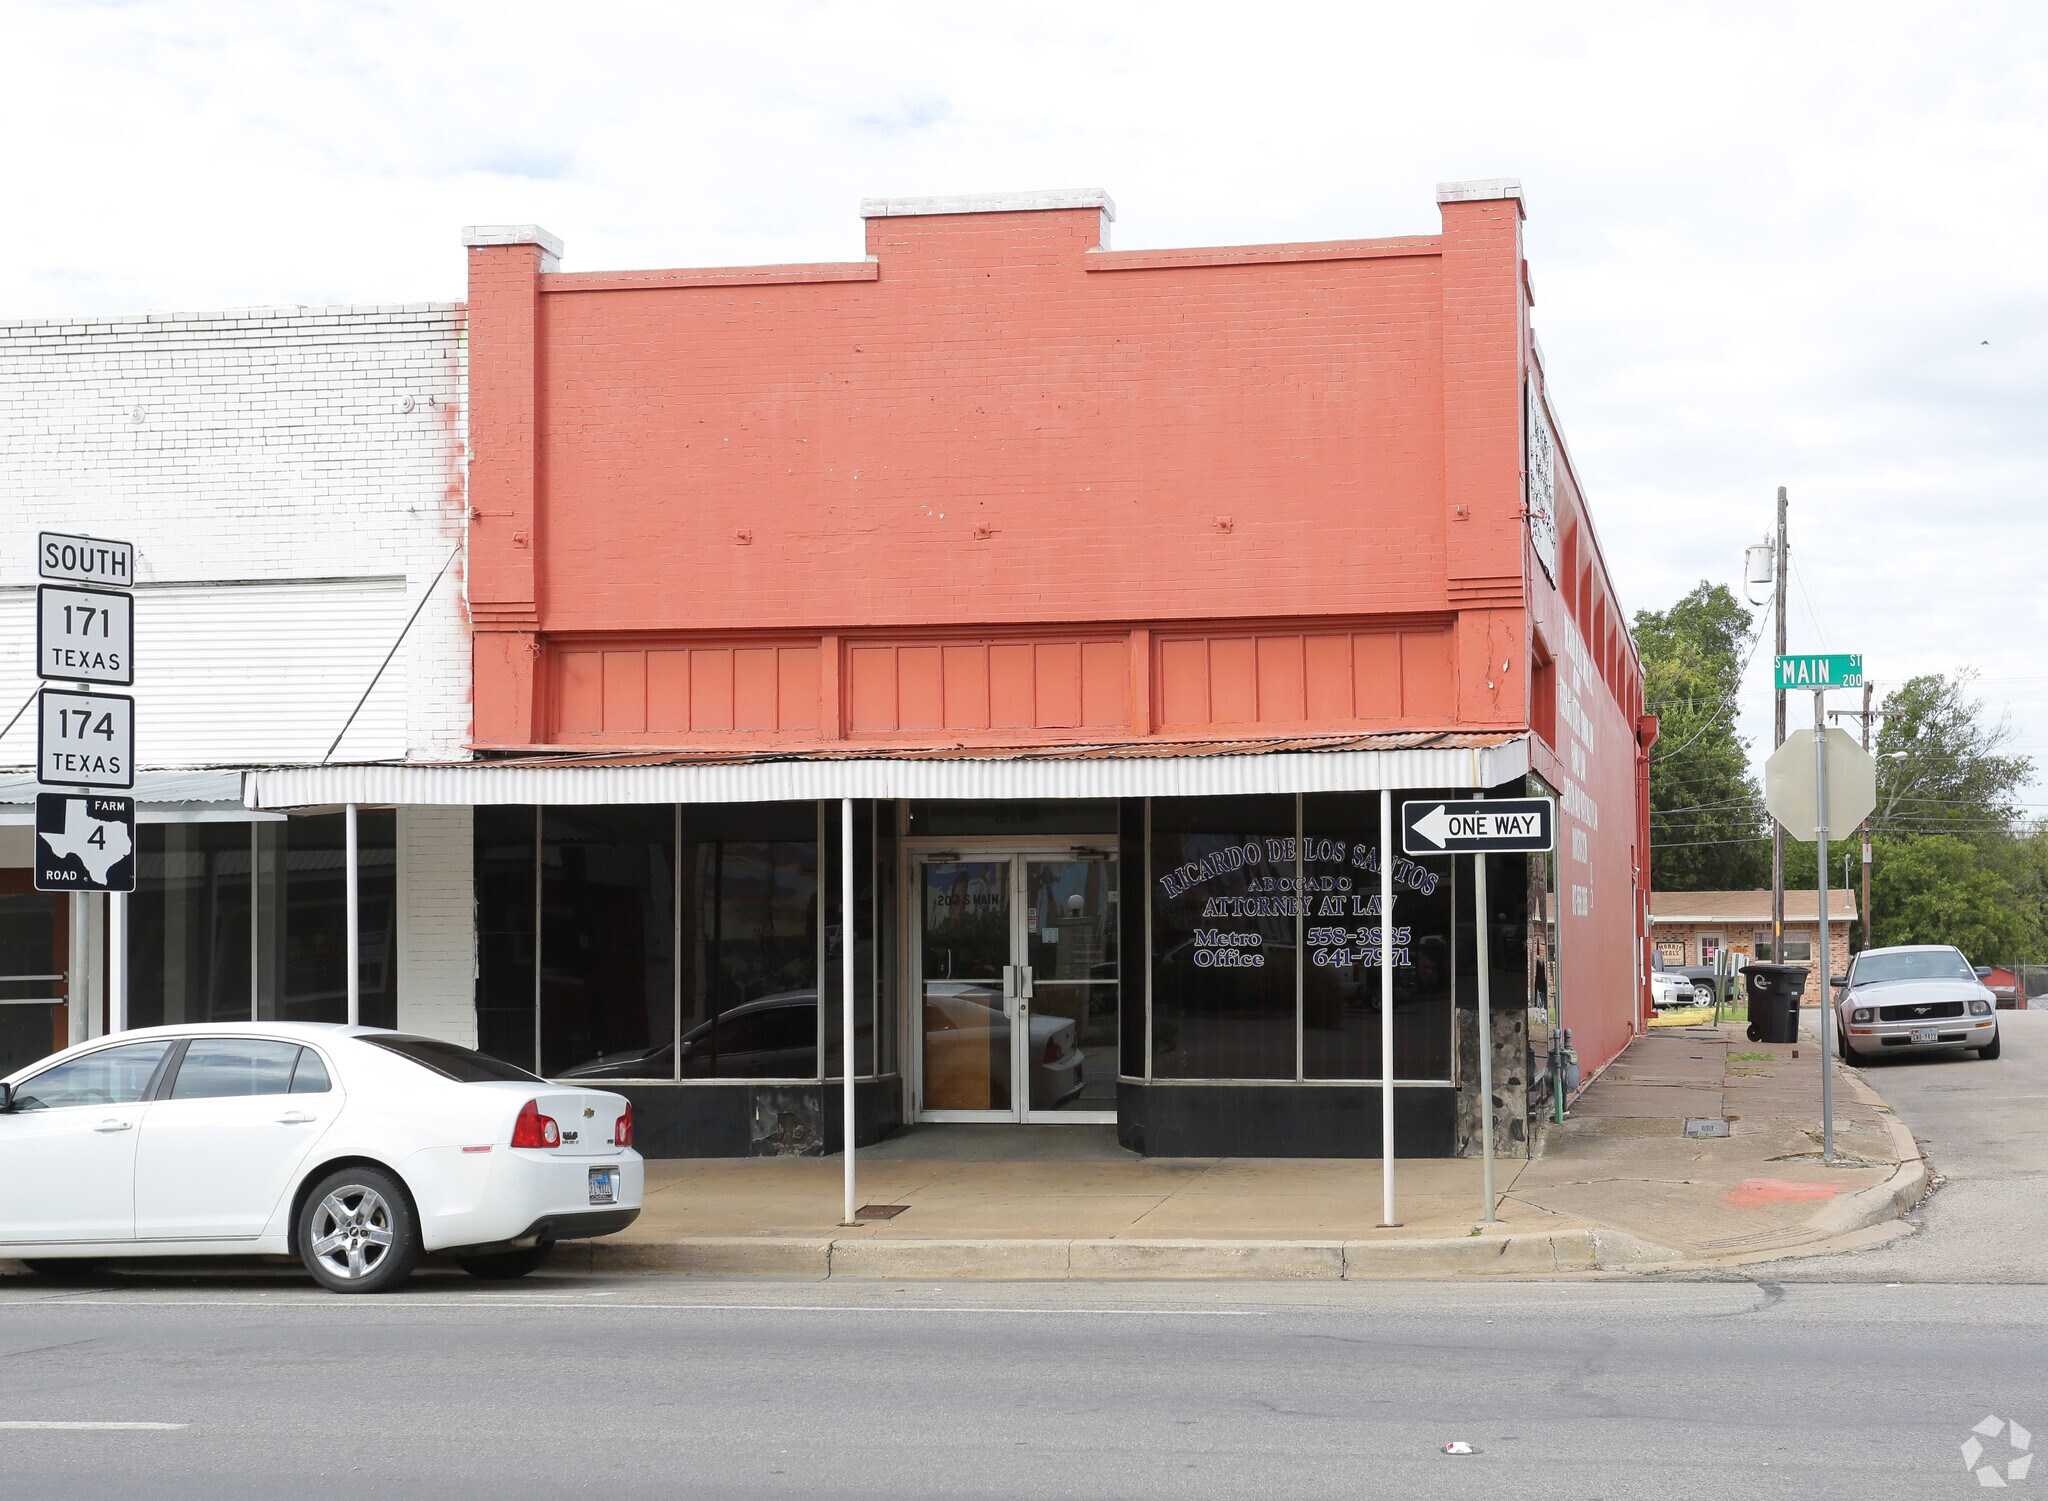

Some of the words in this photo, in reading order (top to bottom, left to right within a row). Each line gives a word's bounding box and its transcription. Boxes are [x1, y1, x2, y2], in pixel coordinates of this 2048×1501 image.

[45, 542, 126, 577] SOUTH
[63, 605, 109, 638] 171
[52, 648, 121, 671] TEXAS
[1775, 656, 1781, 668] S
[1783, 659, 1829, 684] MAIN
[1850, 654, 1862, 667] ST
[1843, 673, 1862, 687] 200
[59, 708, 115, 742] 174
[52, 753, 121, 774] TEXAS
[94, 800, 125, 812] FARM
[1449, 816, 1487, 836] ONE
[1495, 815, 1535, 836] WAY
[87, 825, 106, 851] 4
[46, 870, 78, 881] ROAD
[1160, 842, 1262, 899] RICARDO
[1265, 837, 1297, 863] DE
[1303, 837, 1347, 863] LOS
[1248, 876, 1353, 892] ABOGADO
[1203, 896, 1313, 918] ATTORNEY
[1318, 895, 1347, 917] AT
[1194, 928, 1262, 947] Metro
[1193, 948, 1265, 968] Office
